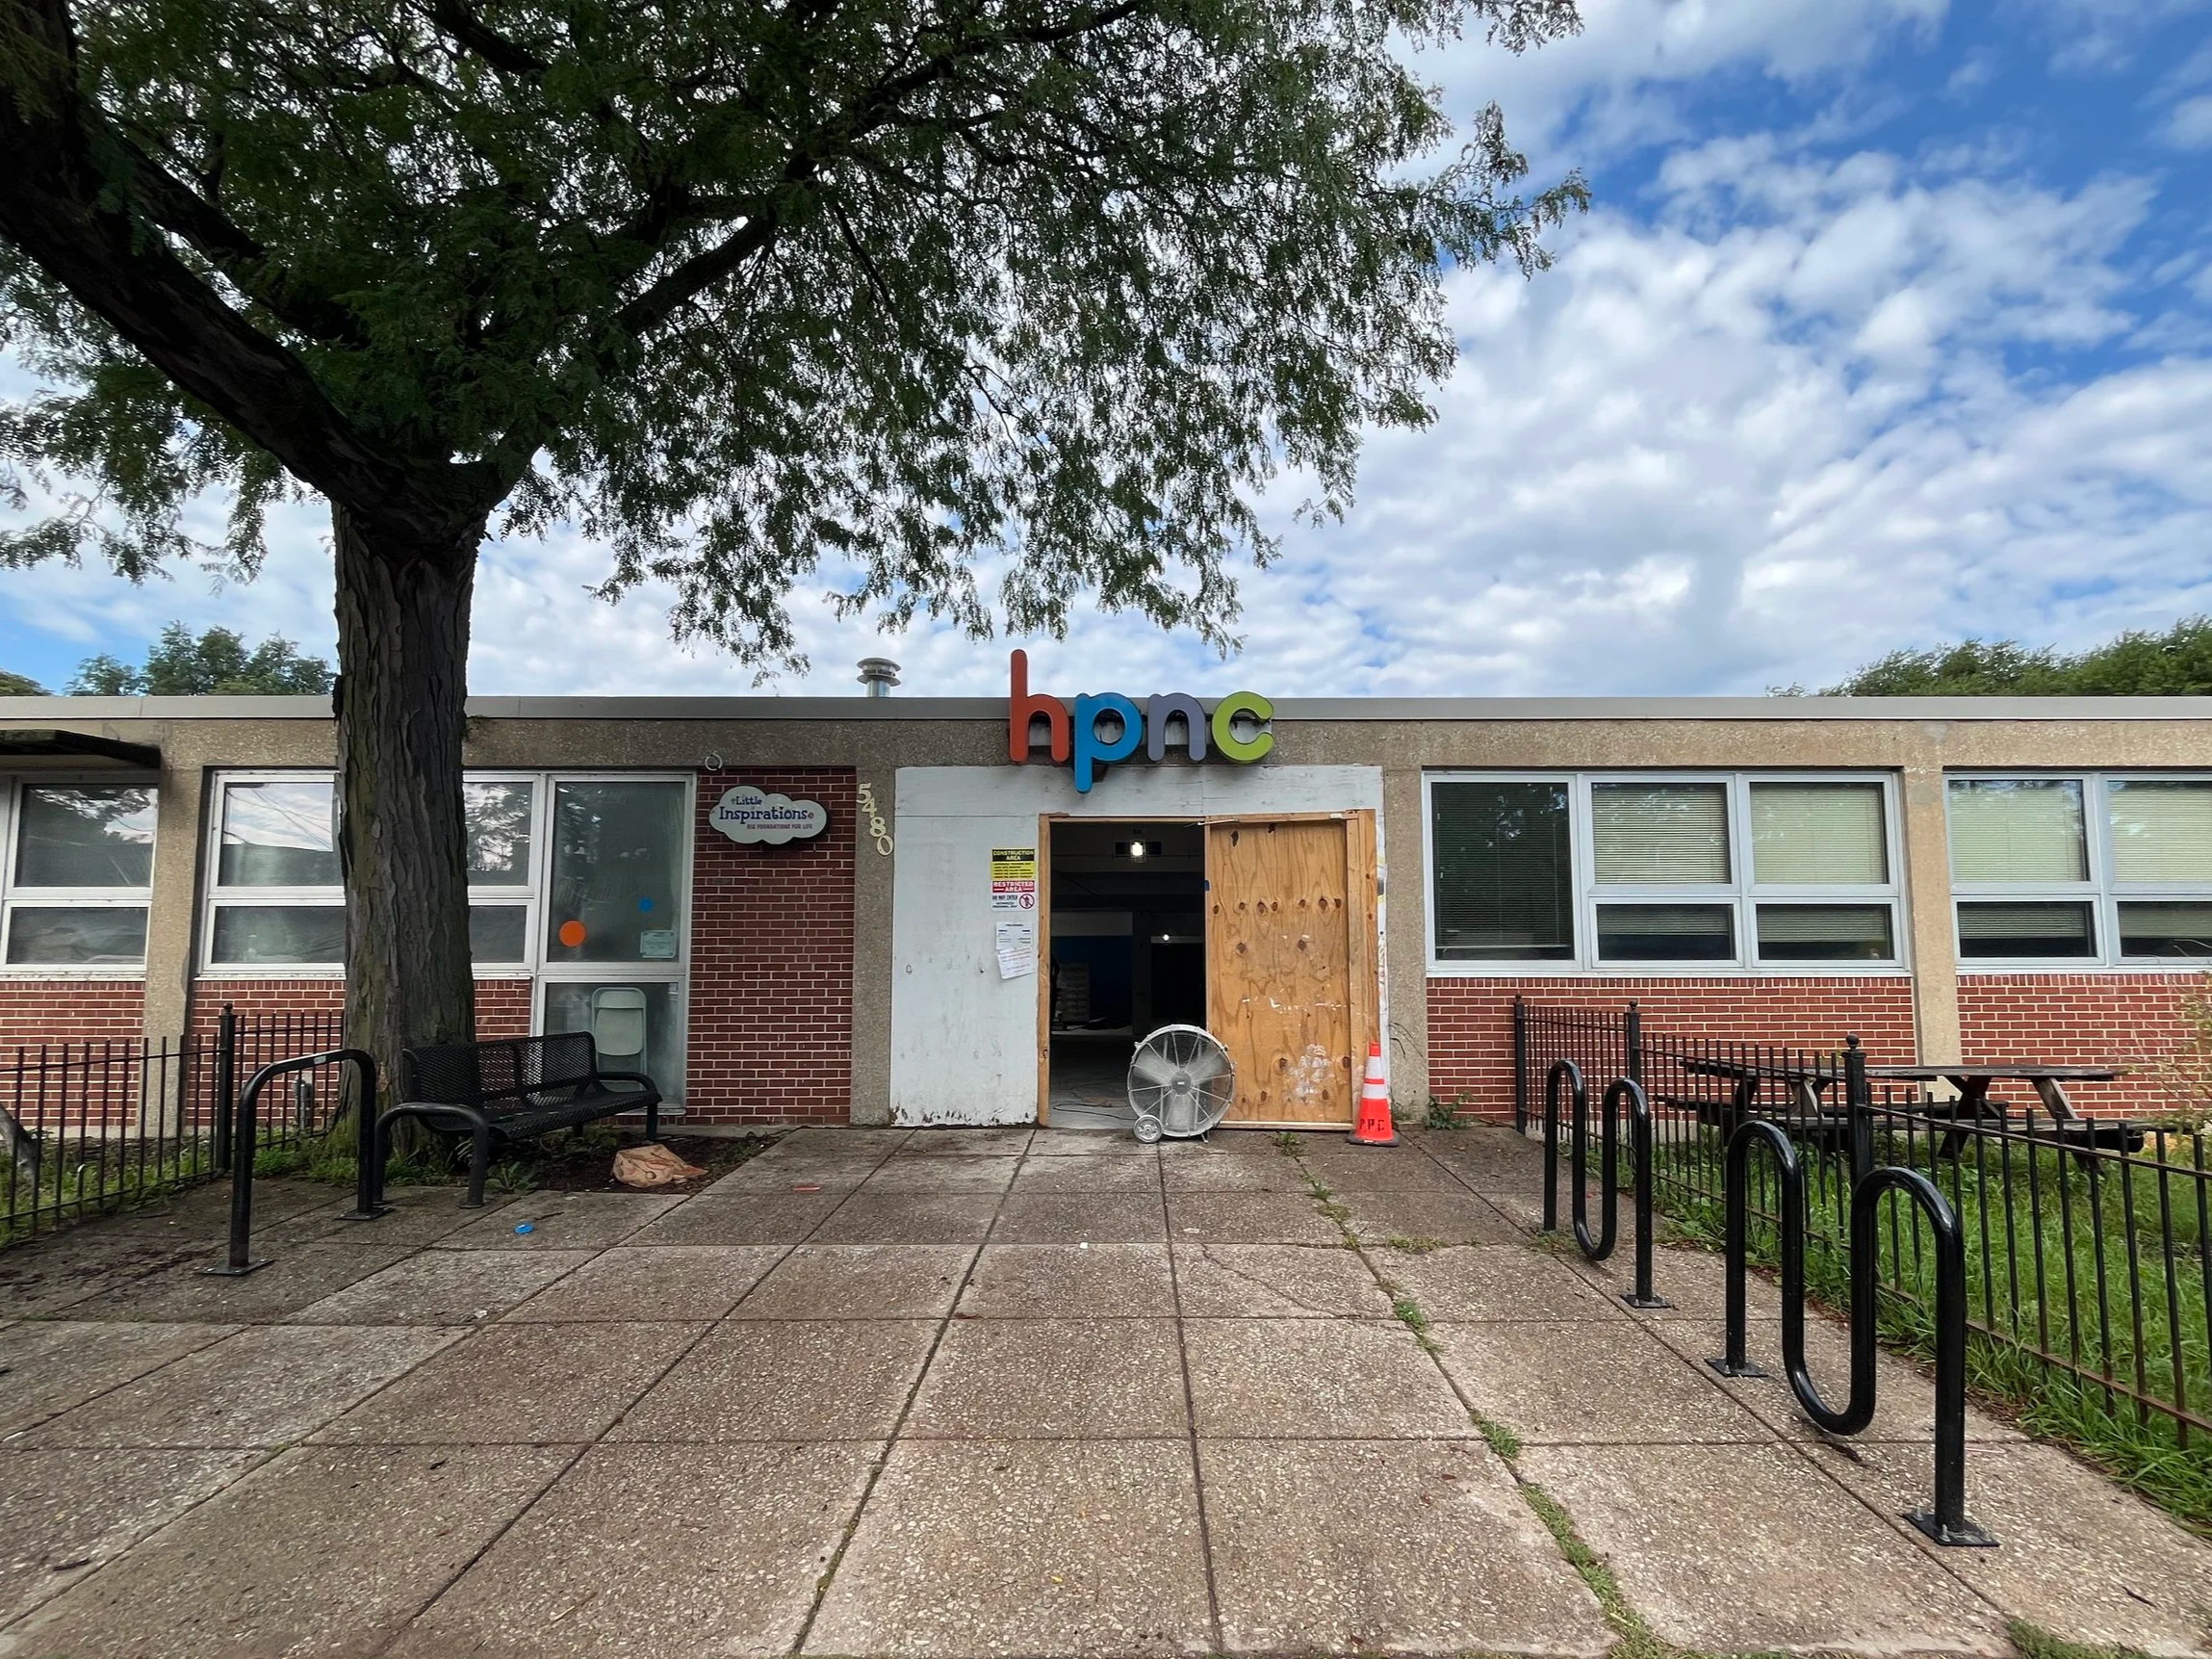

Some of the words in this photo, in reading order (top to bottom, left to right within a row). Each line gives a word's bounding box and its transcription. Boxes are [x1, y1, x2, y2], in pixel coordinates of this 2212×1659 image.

[1010, 648, 1274, 793] hpnc
[719, 806, 808, 824] Inspirations
[734, 795, 762, 805] Little
[856, 782, 893, 856] 5480
